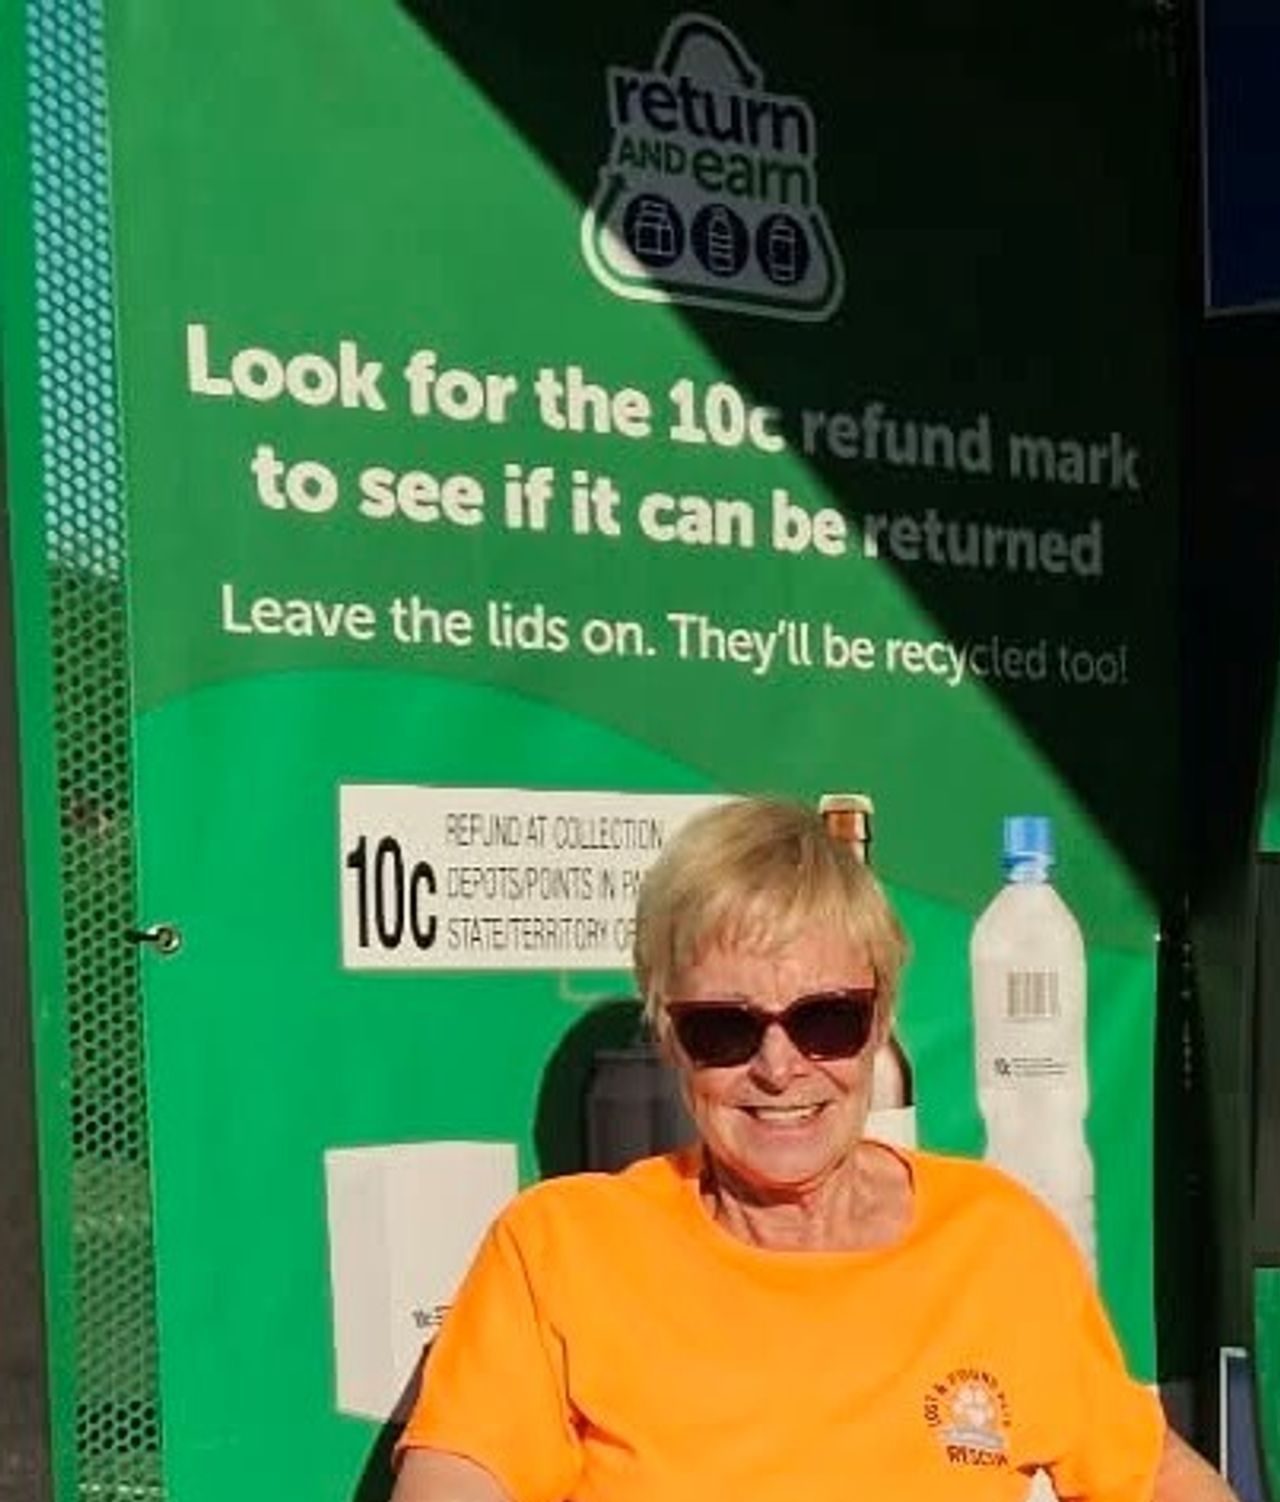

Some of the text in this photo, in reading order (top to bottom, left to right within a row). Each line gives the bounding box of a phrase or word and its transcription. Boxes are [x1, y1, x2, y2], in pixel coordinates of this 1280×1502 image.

[614, 77, 808, 153] return
[619, 137, 808, 205] AND earn
[187, 324, 1141, 490] Look for the 10c refund mark
[251, 443, 1104, 576] to see if it can be returned
[222, 583, 1128, 687] Leave the lids on. They'll be recycled too!
[446, 813, 662, 850] REFUND AT COLLECTION
[347, 835, 436, 949] 10c
[602, 868, 615, 900] IN
